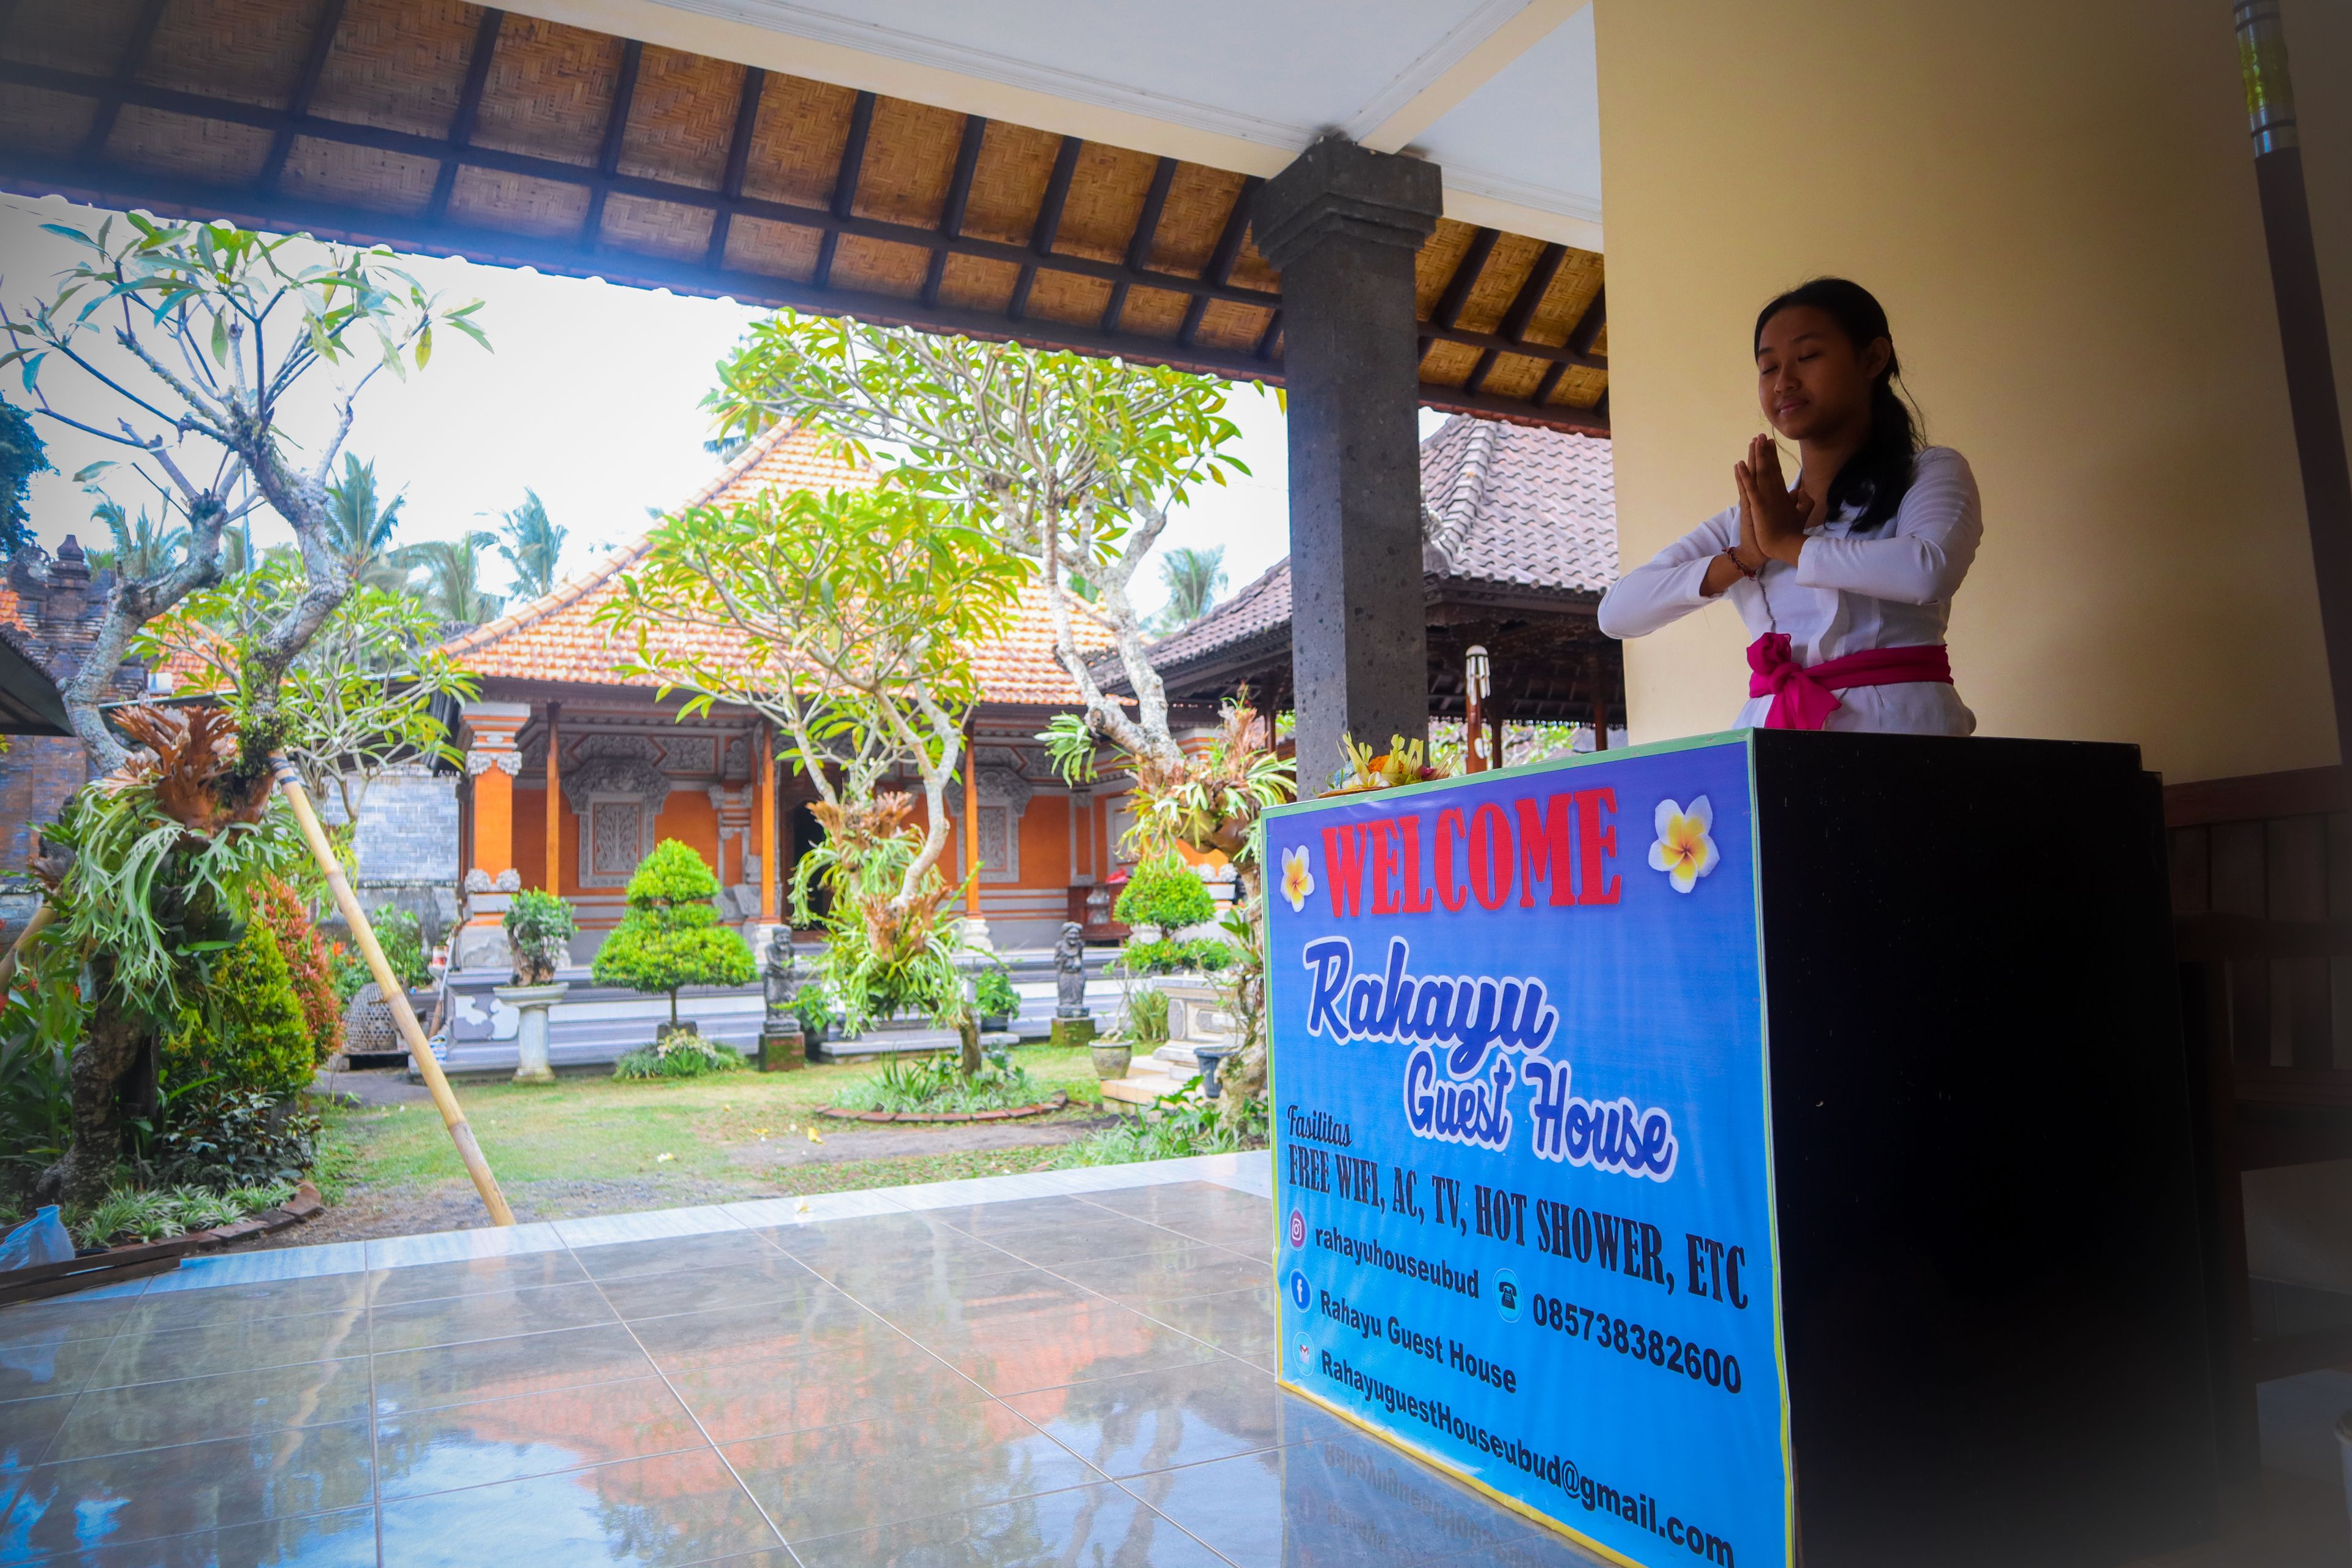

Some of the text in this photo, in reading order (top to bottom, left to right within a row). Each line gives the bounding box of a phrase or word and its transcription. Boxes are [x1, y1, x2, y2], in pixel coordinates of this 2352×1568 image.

[1321, 786, 1621, 918] WELCOME
[1303, 936, 1559, 1081] Rahayu
[1288, 1104, 1352, 1147] Fasilitas
[1404, 1046, 1679, 1183] Guest House
[1289, 1144, 1748, 1310] FREE WIFI, AC, TV, HOT SHOWER, ETC
[1315, 1226, 1479, 1299] rahayuhouseubud
[1321, 1289, 1517, 1394] Rahayu Guest House
[1533, 1293, 1742, 1394] 085738382600
[1321, 1349, 1735, 1568] RahayuguestHouseubud@gmail.com
